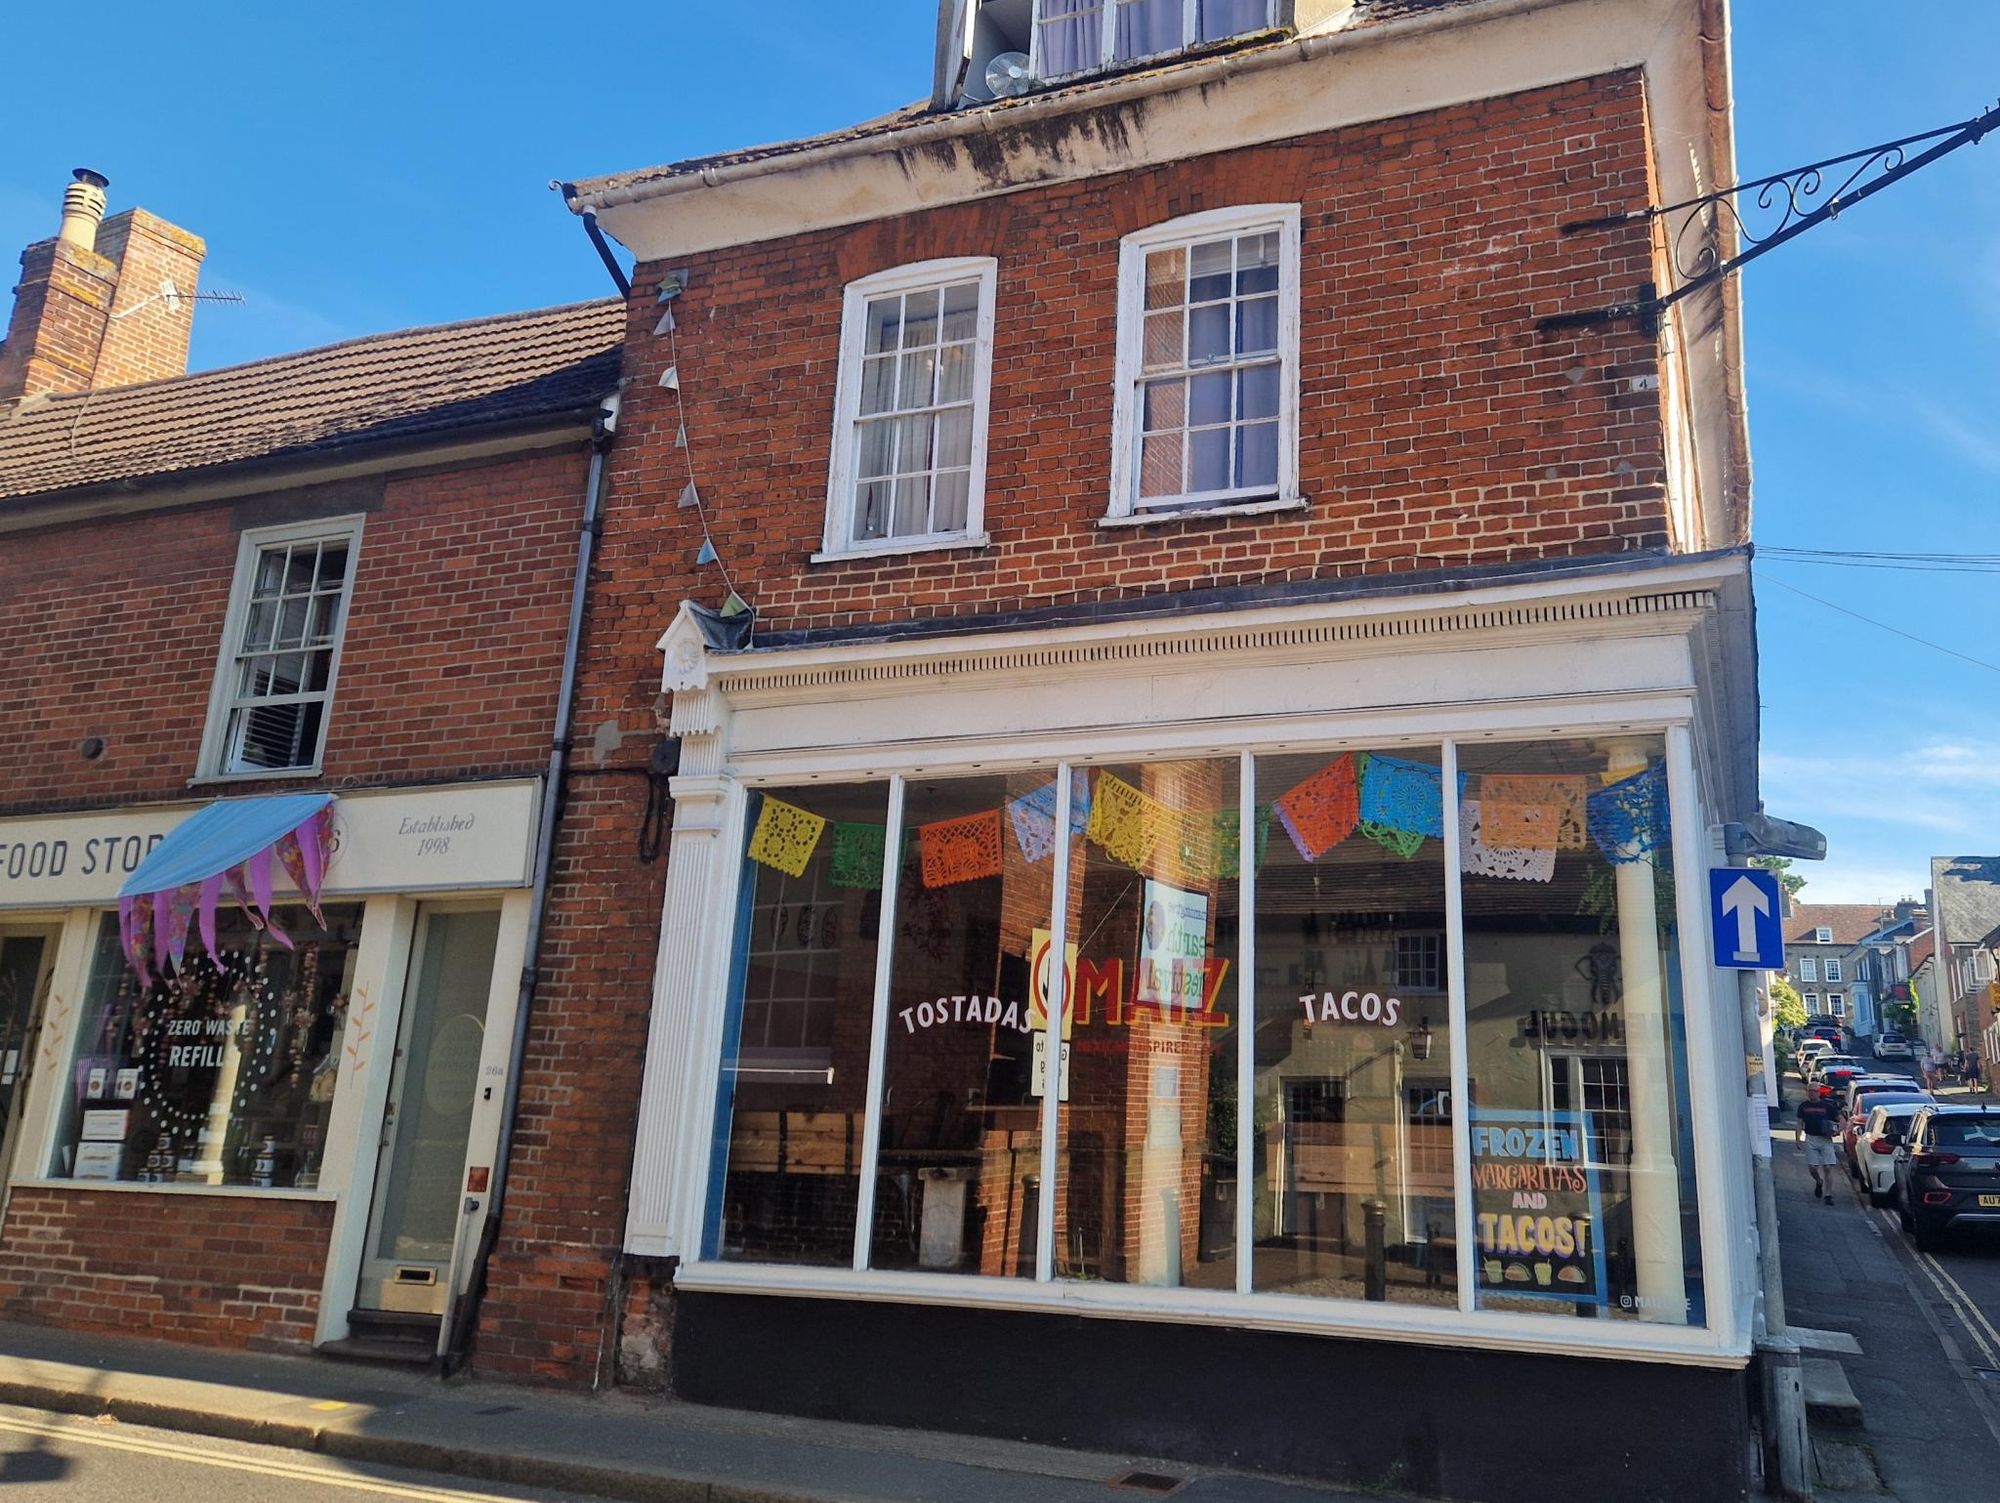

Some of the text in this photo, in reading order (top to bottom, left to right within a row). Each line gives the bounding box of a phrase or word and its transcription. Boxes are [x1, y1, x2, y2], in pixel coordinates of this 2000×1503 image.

[398, 812, 475, 835] Established
[417, 836, 451, 857] 1998
[1074, 957, 1231, 1028] MAIZ
[898, 995, 1036, 1034] TOSTADAS
[1299, 991, 1401, 1027] TACOS
[167, 1020, 201, 1036] ZERO
[1471, 1126, 1580, 1160] FROZEN
[1472, 1163, 1588, 1194] MARGARITAS
[1512, 1191, 1548, 1210] AND
[1477, 1213, 1587, 1258] TACOS!
